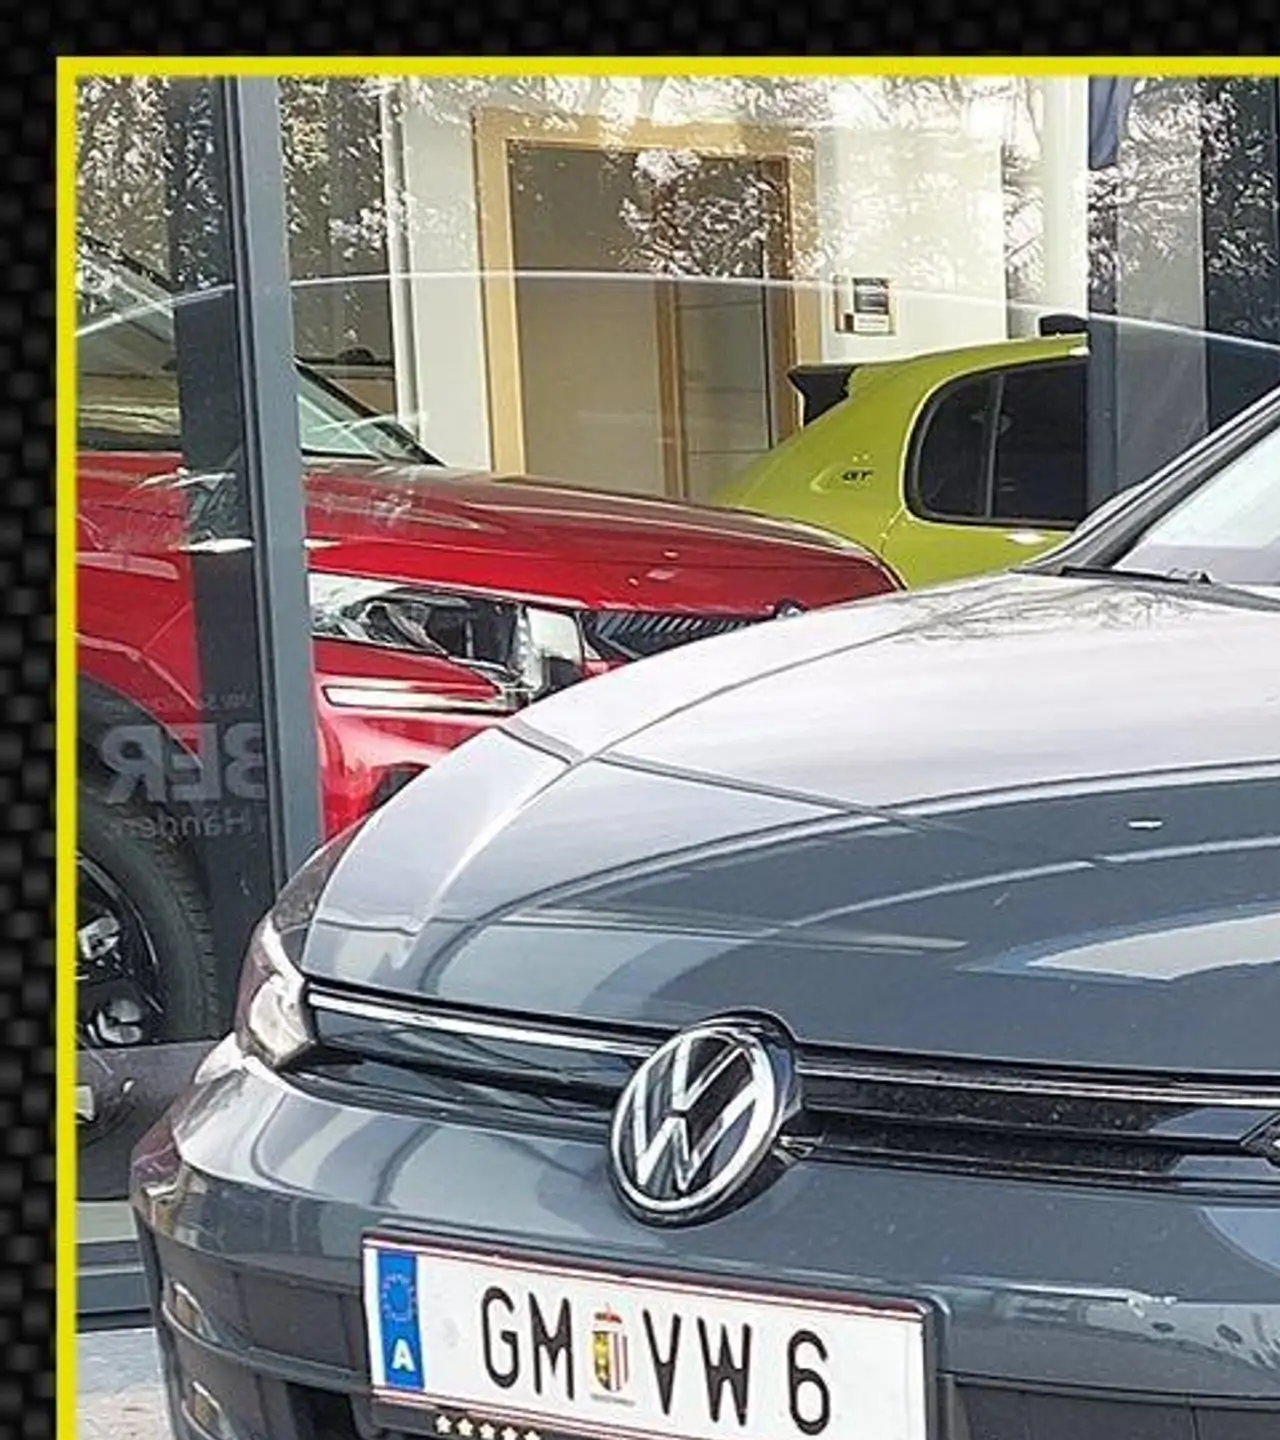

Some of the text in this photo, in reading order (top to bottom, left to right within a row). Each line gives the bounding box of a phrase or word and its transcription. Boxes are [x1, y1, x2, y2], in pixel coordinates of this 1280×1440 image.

[390, 1337, 417, 1373] A
[480, 1285, 831, 1436] GM VW 6
